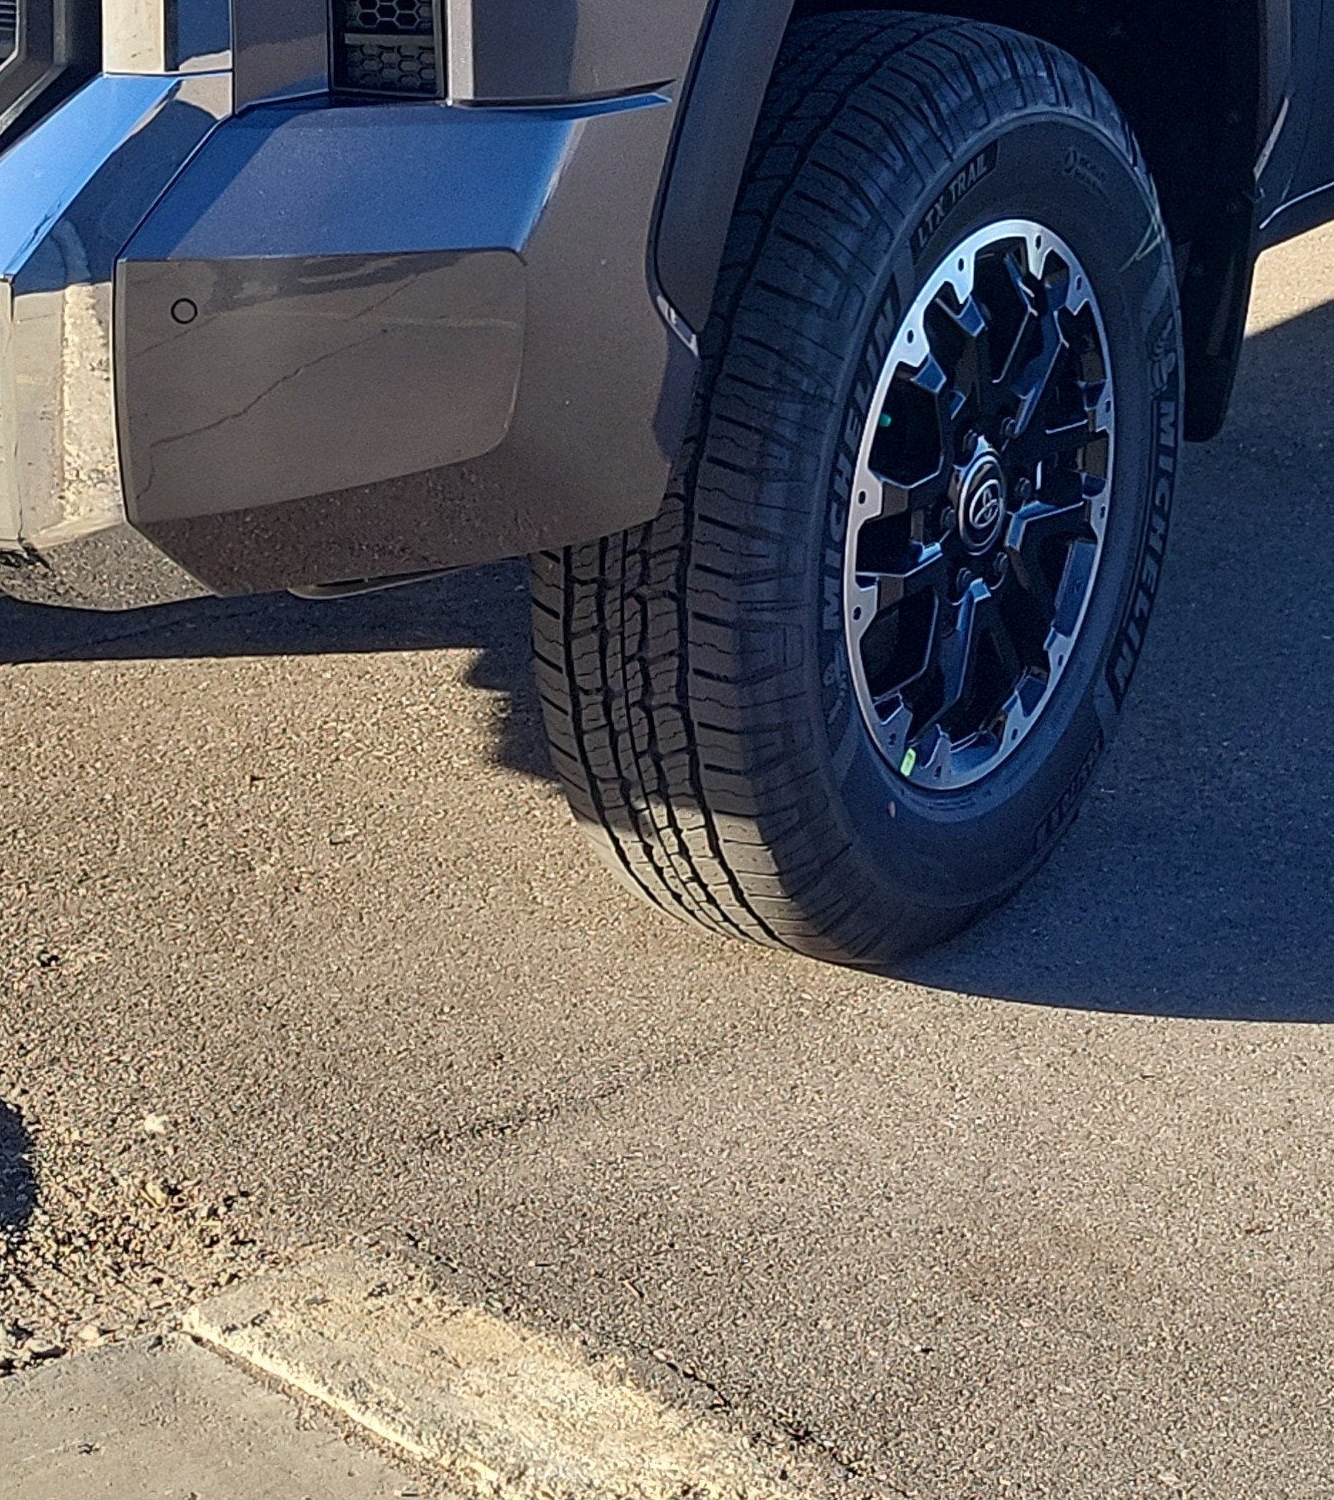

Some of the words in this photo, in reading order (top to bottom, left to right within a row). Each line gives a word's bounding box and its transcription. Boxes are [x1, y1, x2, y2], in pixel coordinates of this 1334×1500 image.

[917, 195, 946, 249] LTX
[948, 153, 988, 204] TRAIL
[821, 295, 899, 631] MICHELIN
[1113, 400, 1178, 690] MICHELIN
